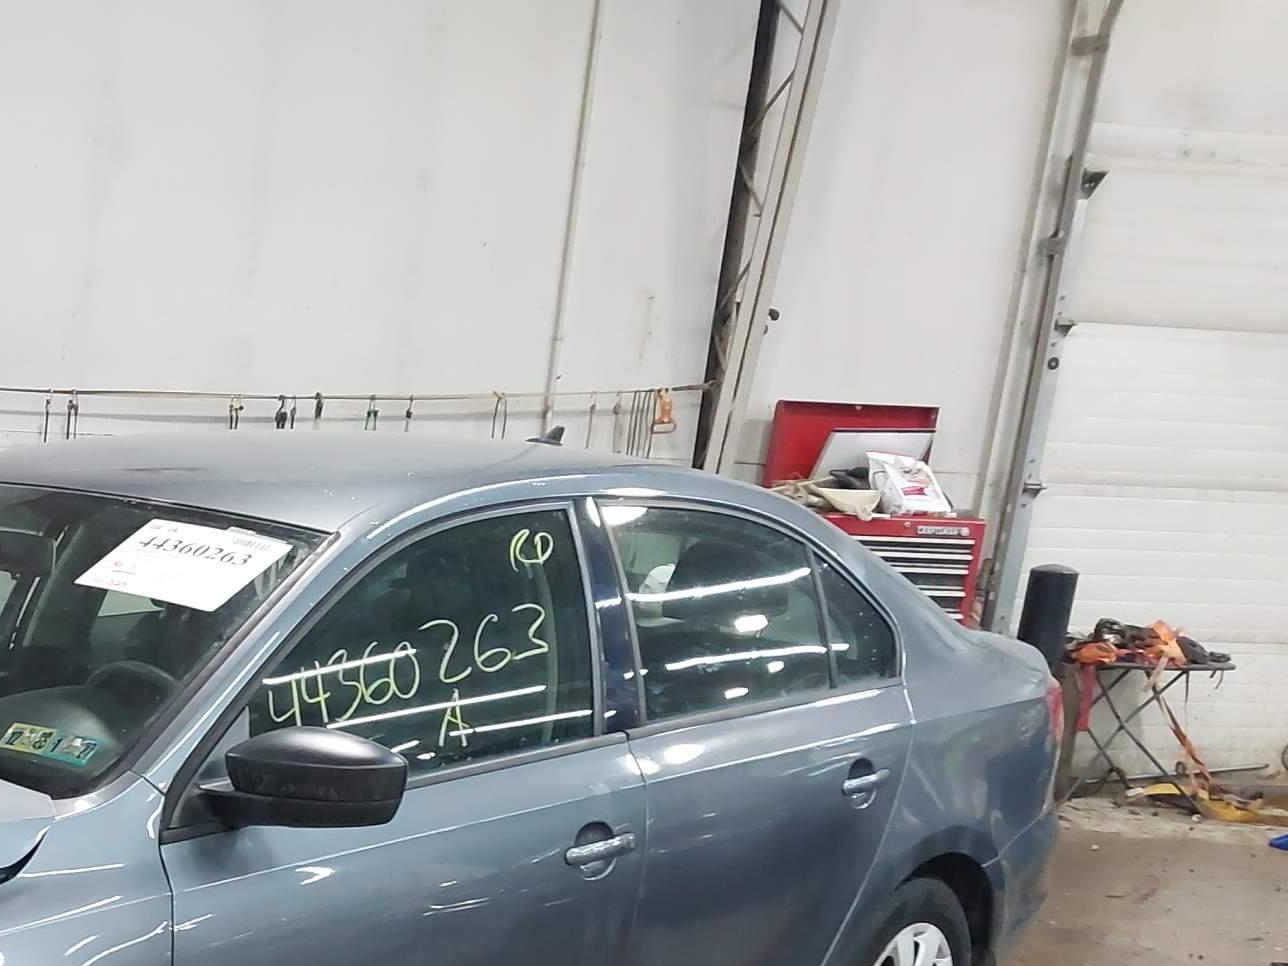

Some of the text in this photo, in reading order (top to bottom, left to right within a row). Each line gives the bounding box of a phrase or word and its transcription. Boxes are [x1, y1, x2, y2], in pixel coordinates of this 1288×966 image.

[139, 536, 253, 567] 44360263
[268, 603, 549, 727] 44360263
[438, 688, 471, 748] A
